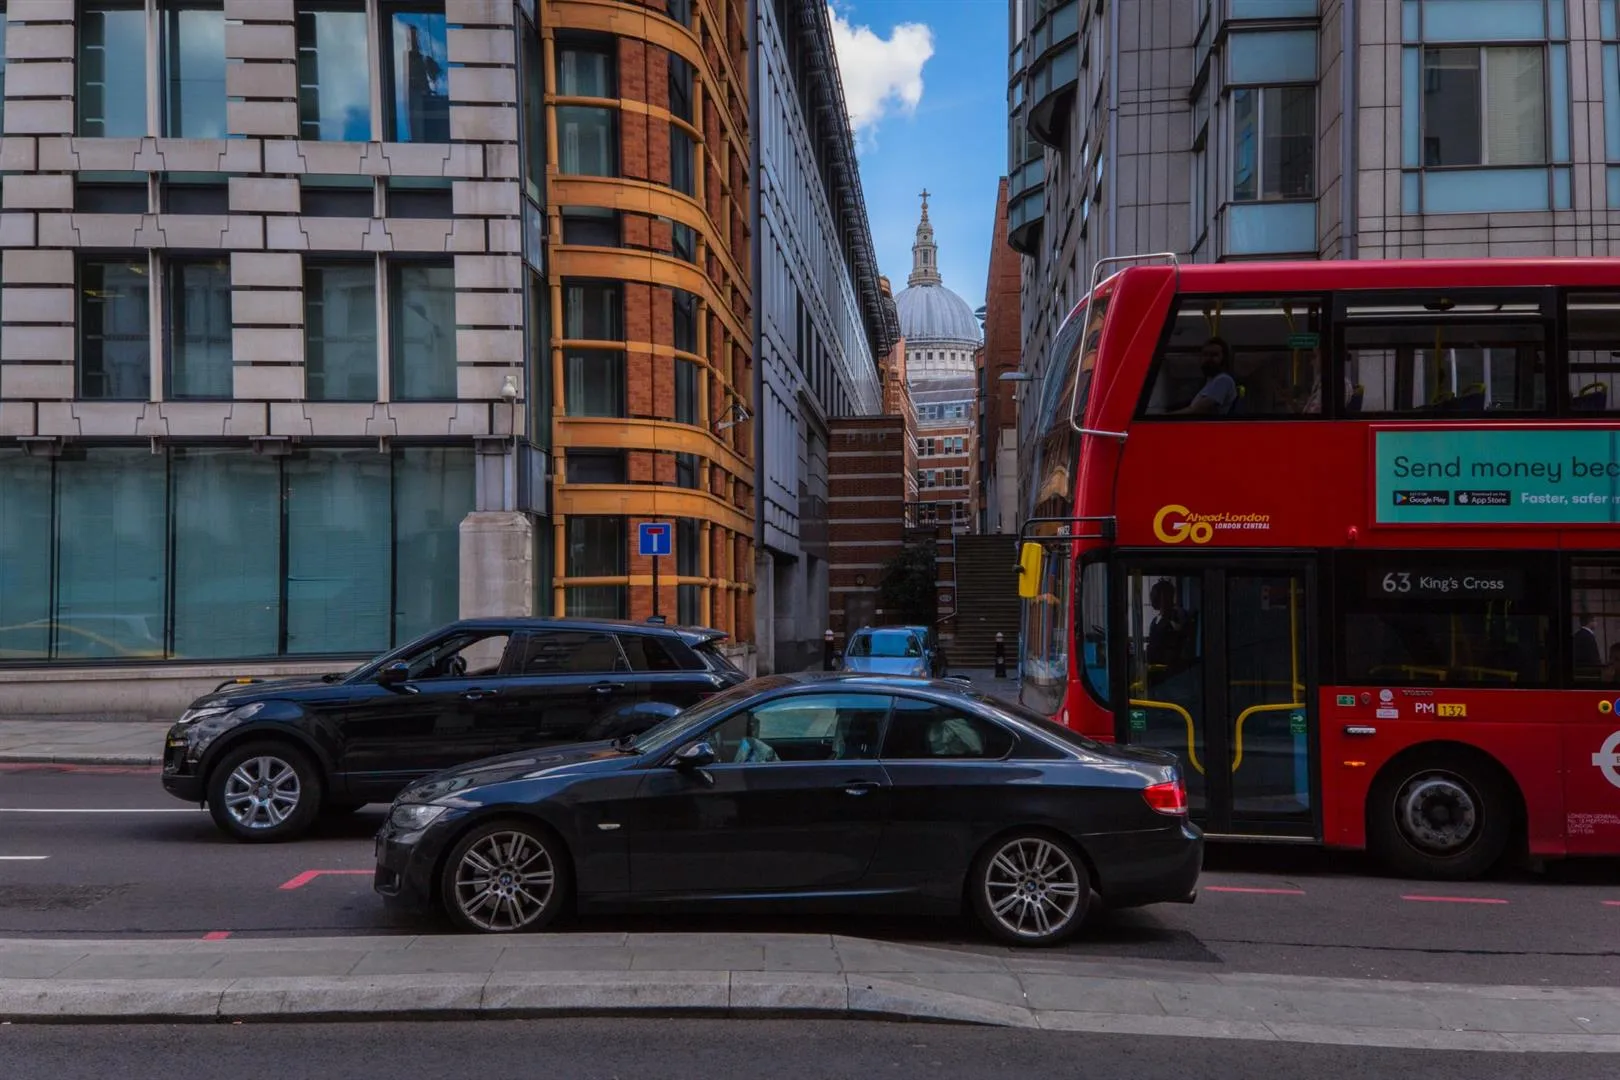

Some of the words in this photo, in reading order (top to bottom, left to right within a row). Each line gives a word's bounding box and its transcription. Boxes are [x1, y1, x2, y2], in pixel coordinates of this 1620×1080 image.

[1393, 455, 1461, 479] Send
[1471, 461, 1562, 484] money
[1409, 496, 1433, 505] Google
[1433, 496, 1447, 505] Play
[1471, 496, 1487, 505] App
[1487, 496, 1507, 504] Store
[1520, 492, 1569, 506] Faster,
[1572, 492, 1606, 504] safer
[1153, 504, 1213, 544] Go
[1186, 512, 1270, 522] Ahead-London
[1382, 572, 1412, 593] 63
[1419, 576, 1459, 593] King's
[1463, 576, 1505, 590] Cross
[1415, 702, 1435, 714] PM
[1441, 705, 1464, 717] 132
